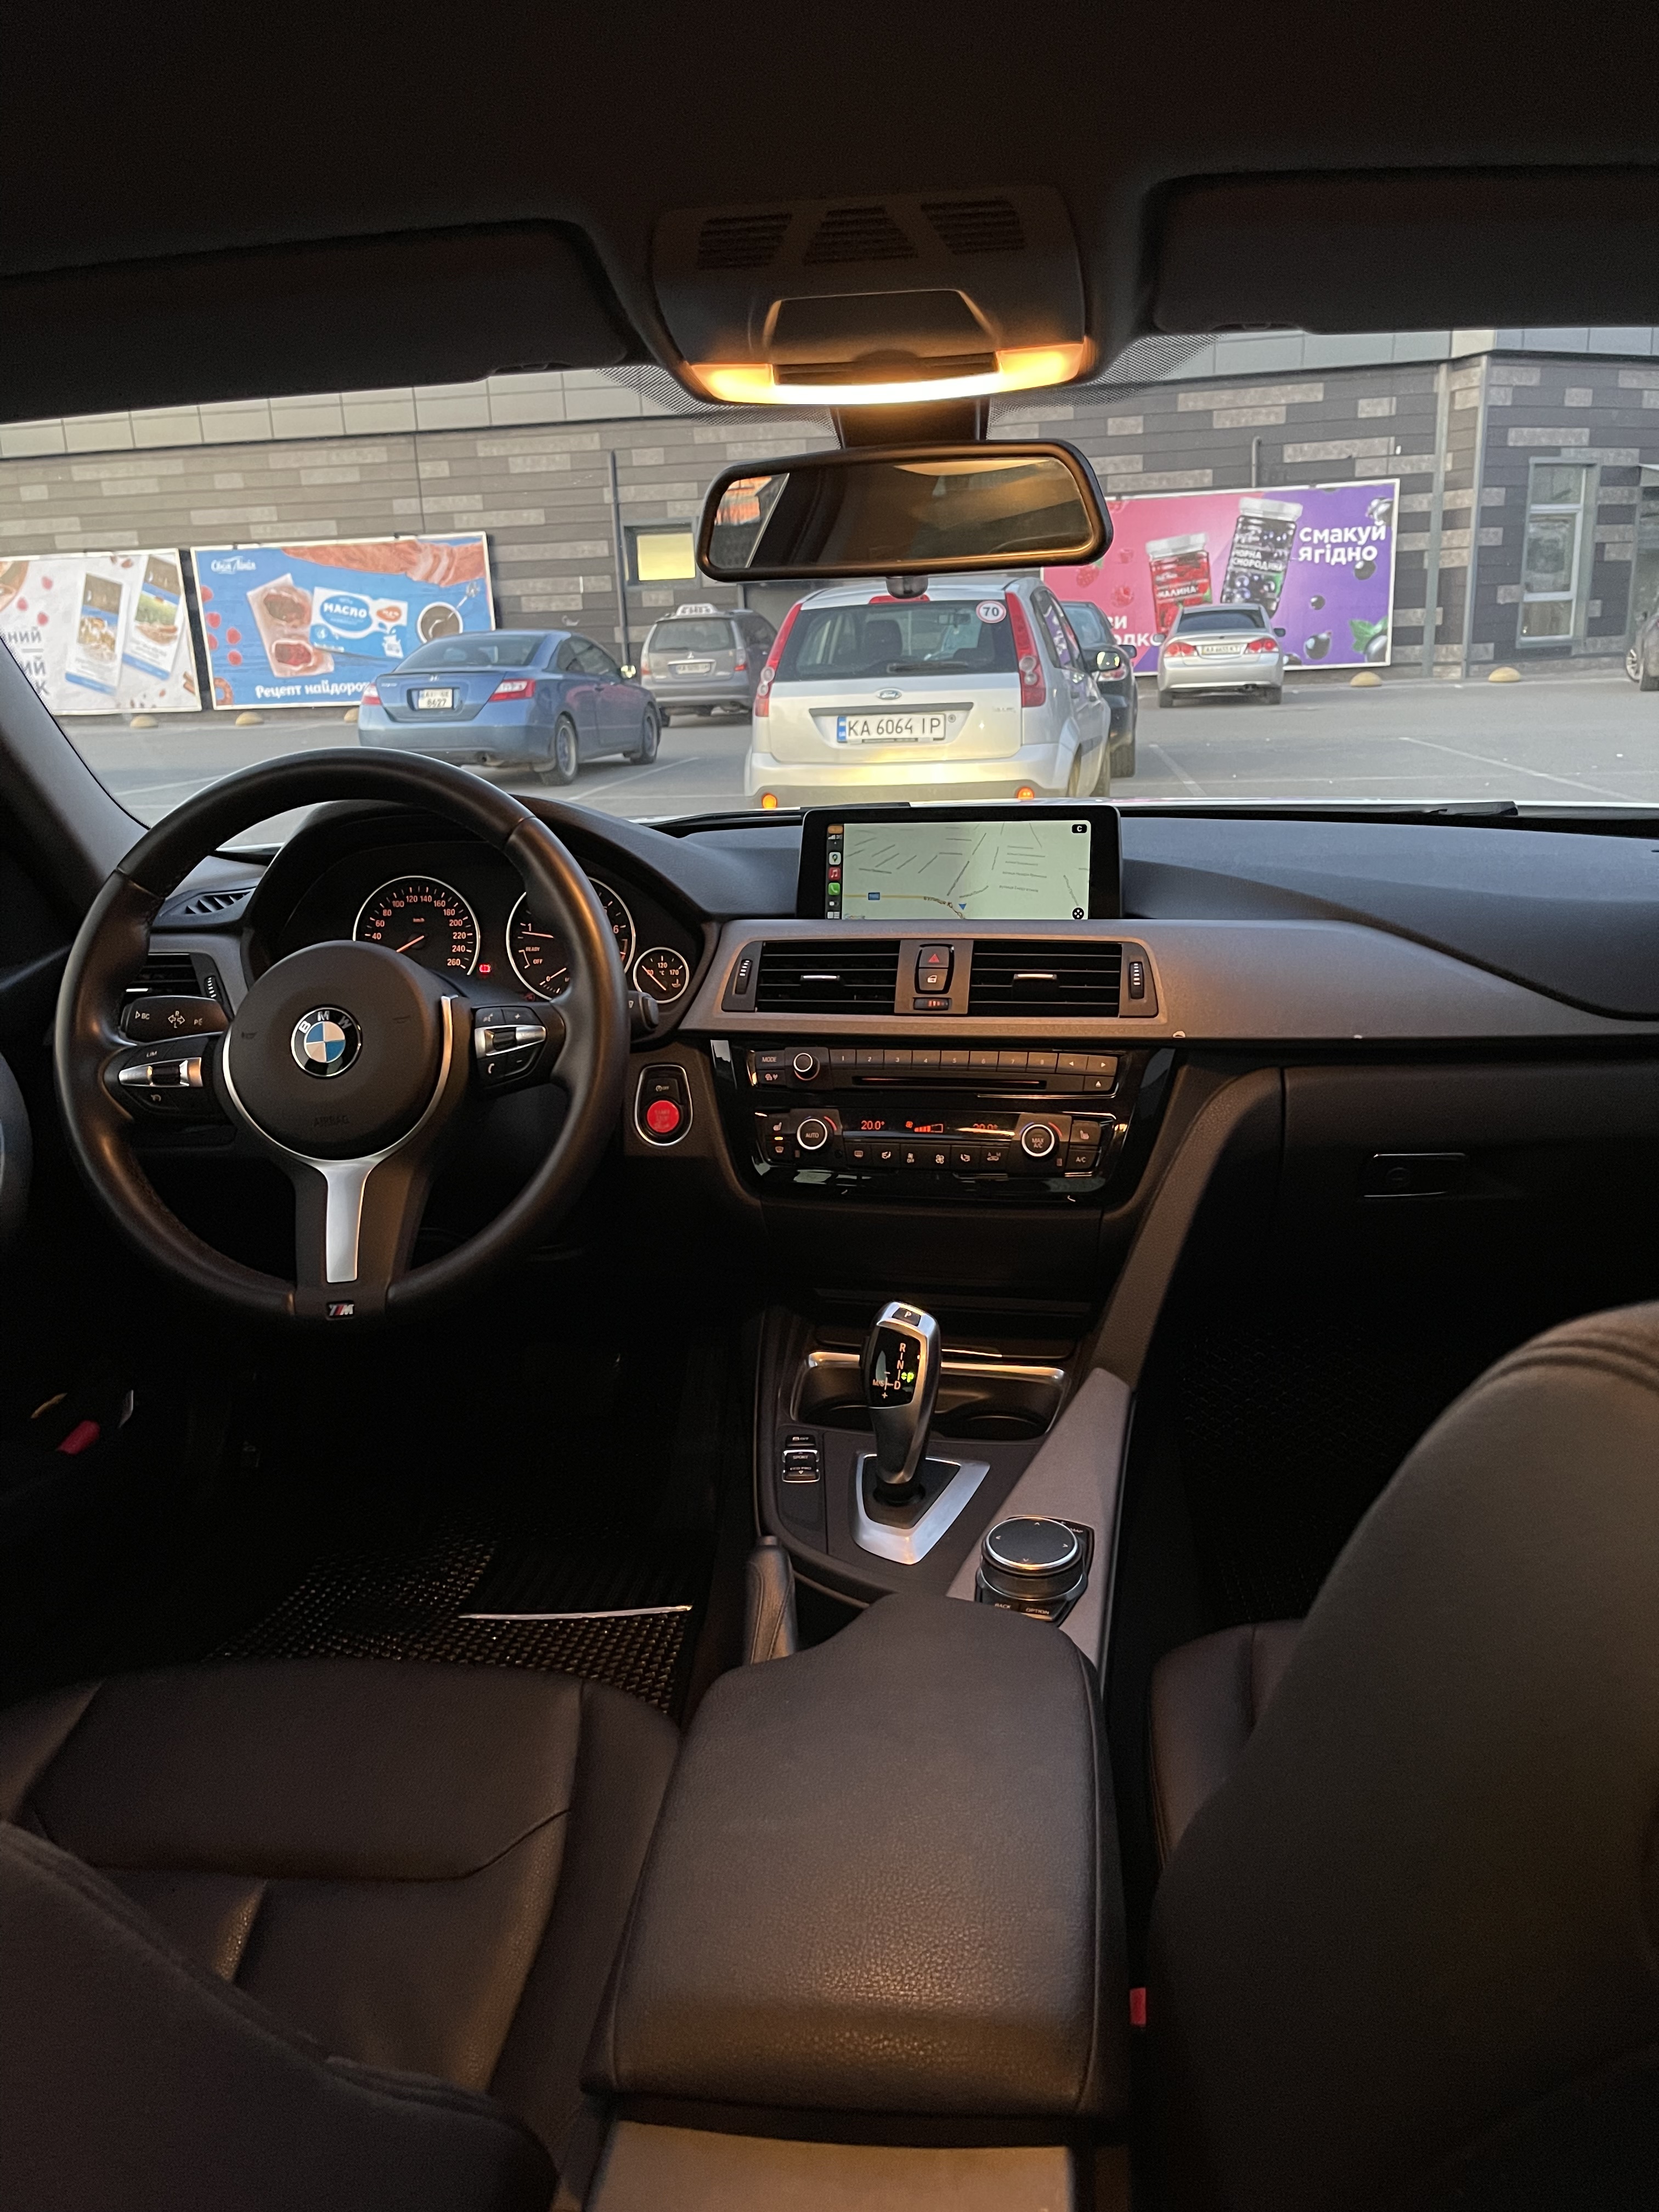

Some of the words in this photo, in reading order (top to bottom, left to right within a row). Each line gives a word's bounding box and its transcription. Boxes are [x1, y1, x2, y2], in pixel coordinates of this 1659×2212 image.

[1299, 520, 1386, 545] смакуй
[1298, 544, 1378, 566] ягідно
[983, 606, 1000, 617] 70
[255, 685, 302, 699] Рецепт
[848, 719, 871, 737] KA
[876, 718, 913, 736] 6064
[921, 717, 941, 734] IP
[528, 923, 532, 932] 1
[613, 924, 619, 934] 6
[447, 958, 461, 966] 260
[298, 1010, 352, 1034] BMW
[899, 1342, 906, 1352] R
[896, 1359, 904, 1370] N
[894, 1380, 901, 1390] D
